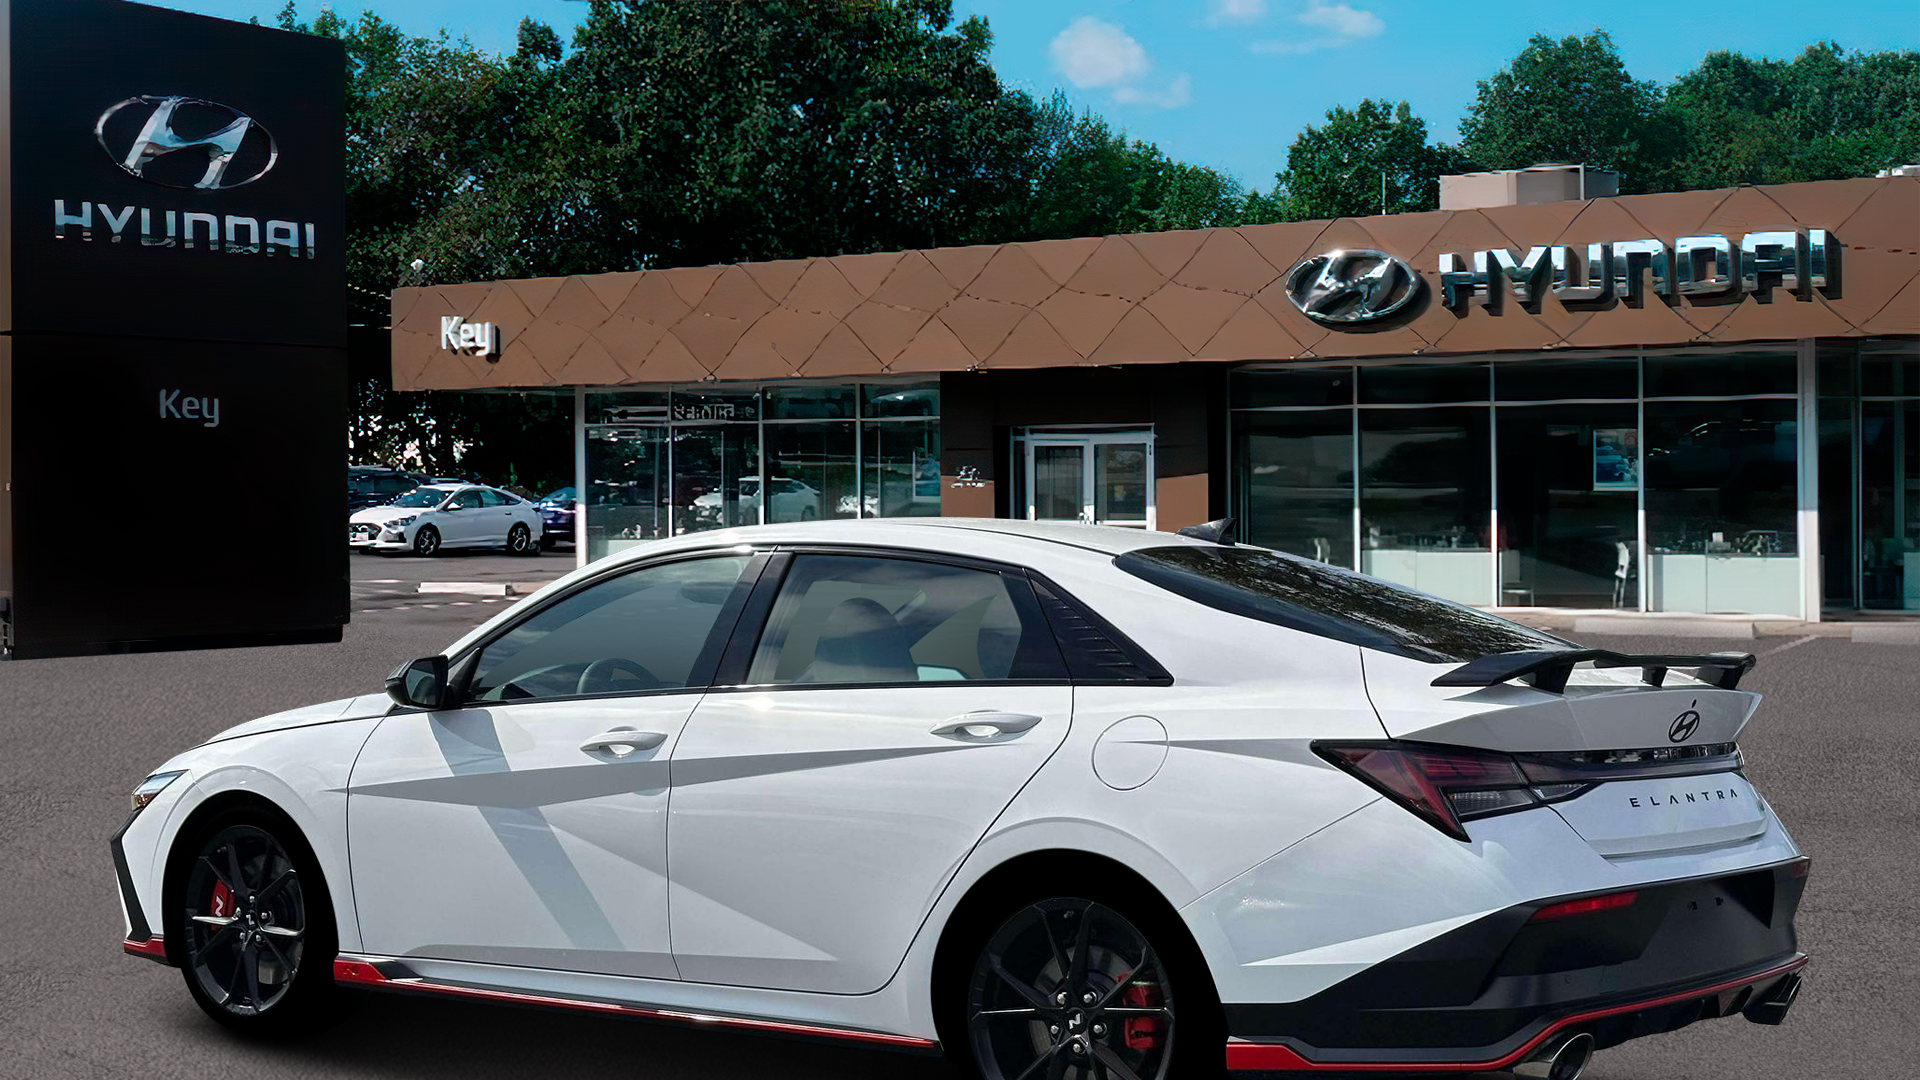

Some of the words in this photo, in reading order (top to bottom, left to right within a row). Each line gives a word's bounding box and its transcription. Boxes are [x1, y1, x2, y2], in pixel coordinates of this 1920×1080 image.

[54, 199, 315, 260] HYUNDAI
[1438, 228, 1832, 304] HYUNDAI
[441, 315, 493, 357] Key
[159, 388, 219, 428] Key
[1628, 788, 1739, 808] ELANTRA
